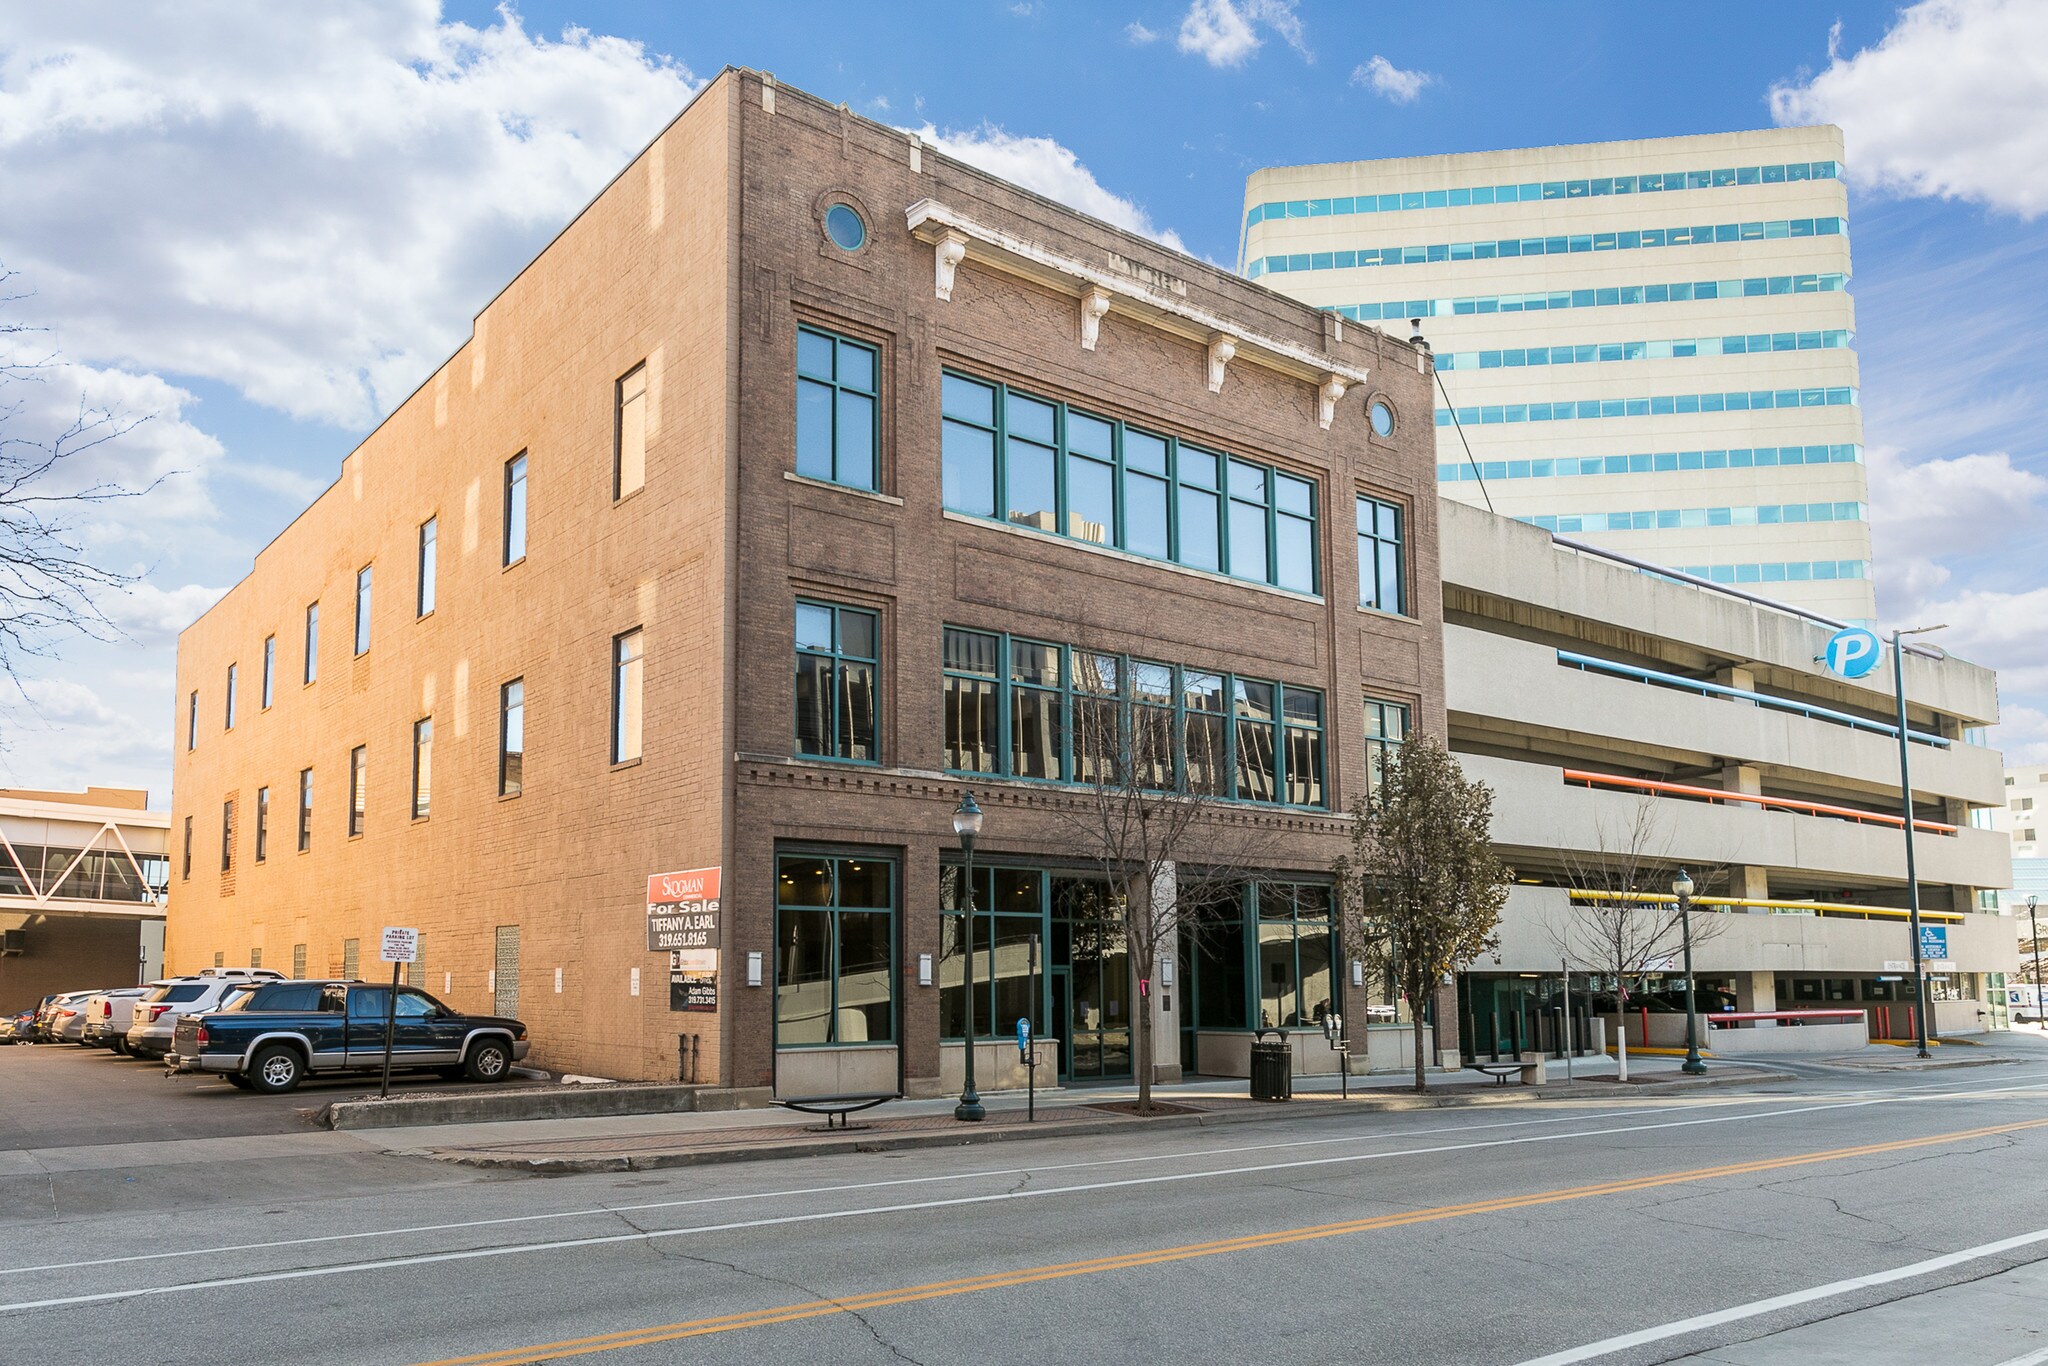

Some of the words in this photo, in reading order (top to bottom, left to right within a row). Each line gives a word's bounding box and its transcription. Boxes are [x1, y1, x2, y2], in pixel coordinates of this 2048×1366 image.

[1834, 633, 1872, 676] P
[662, 876, 704, 898] SKOGMAN
[647, 903, 675, 915] For
[678, 899, 720, 914] Sale
[651, 916, 684, 932] TIFFANY
[684, 916, 694, 930] A.
[694, 914, 716, 929] EARL
[658, 931, 707, 947] 319.651.8165
[688, 986, 702, 995] Adam
[701, 986, 716, 996] Gibbs
